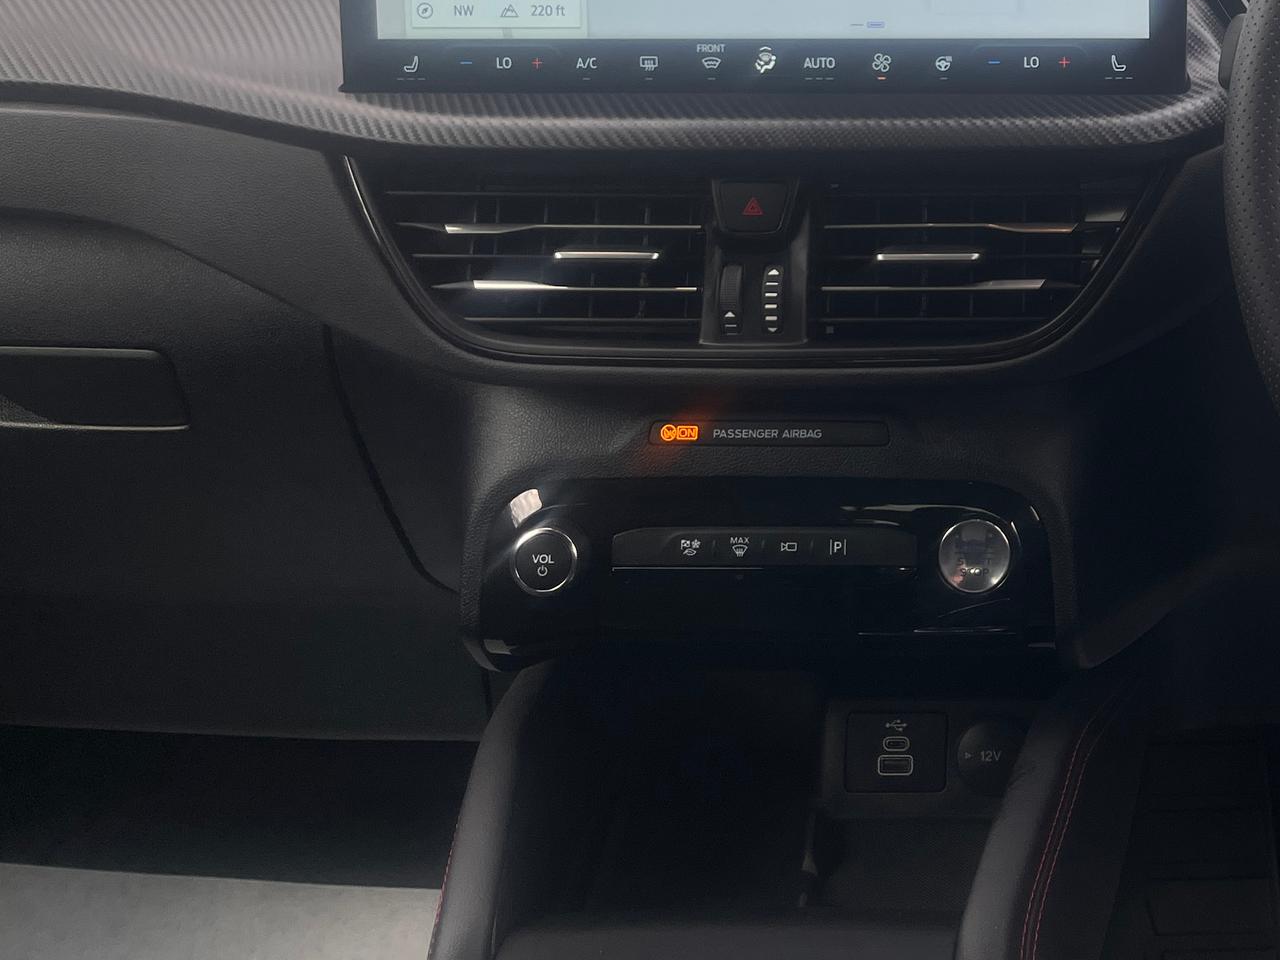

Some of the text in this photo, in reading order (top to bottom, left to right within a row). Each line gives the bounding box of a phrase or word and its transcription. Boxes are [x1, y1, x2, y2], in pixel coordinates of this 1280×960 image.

[453, 4, 475, 17] NW
[530, 4, 566, 17] 220 ft
[696, 43, 726, 53] FRONT
[496, 56, 513, 69] LO
[576, 57, 597, 69] A/C
[803, 57, 836, 69] AUTO
[1023, 56, 1040, 68] LO
[712, 428, 822, 439] PASSENGER AIRBAG
[729, 536, 750, 544] MAX
[531, 554, 555, 564] VOL
[980, 750, 1001, 762] 12V
